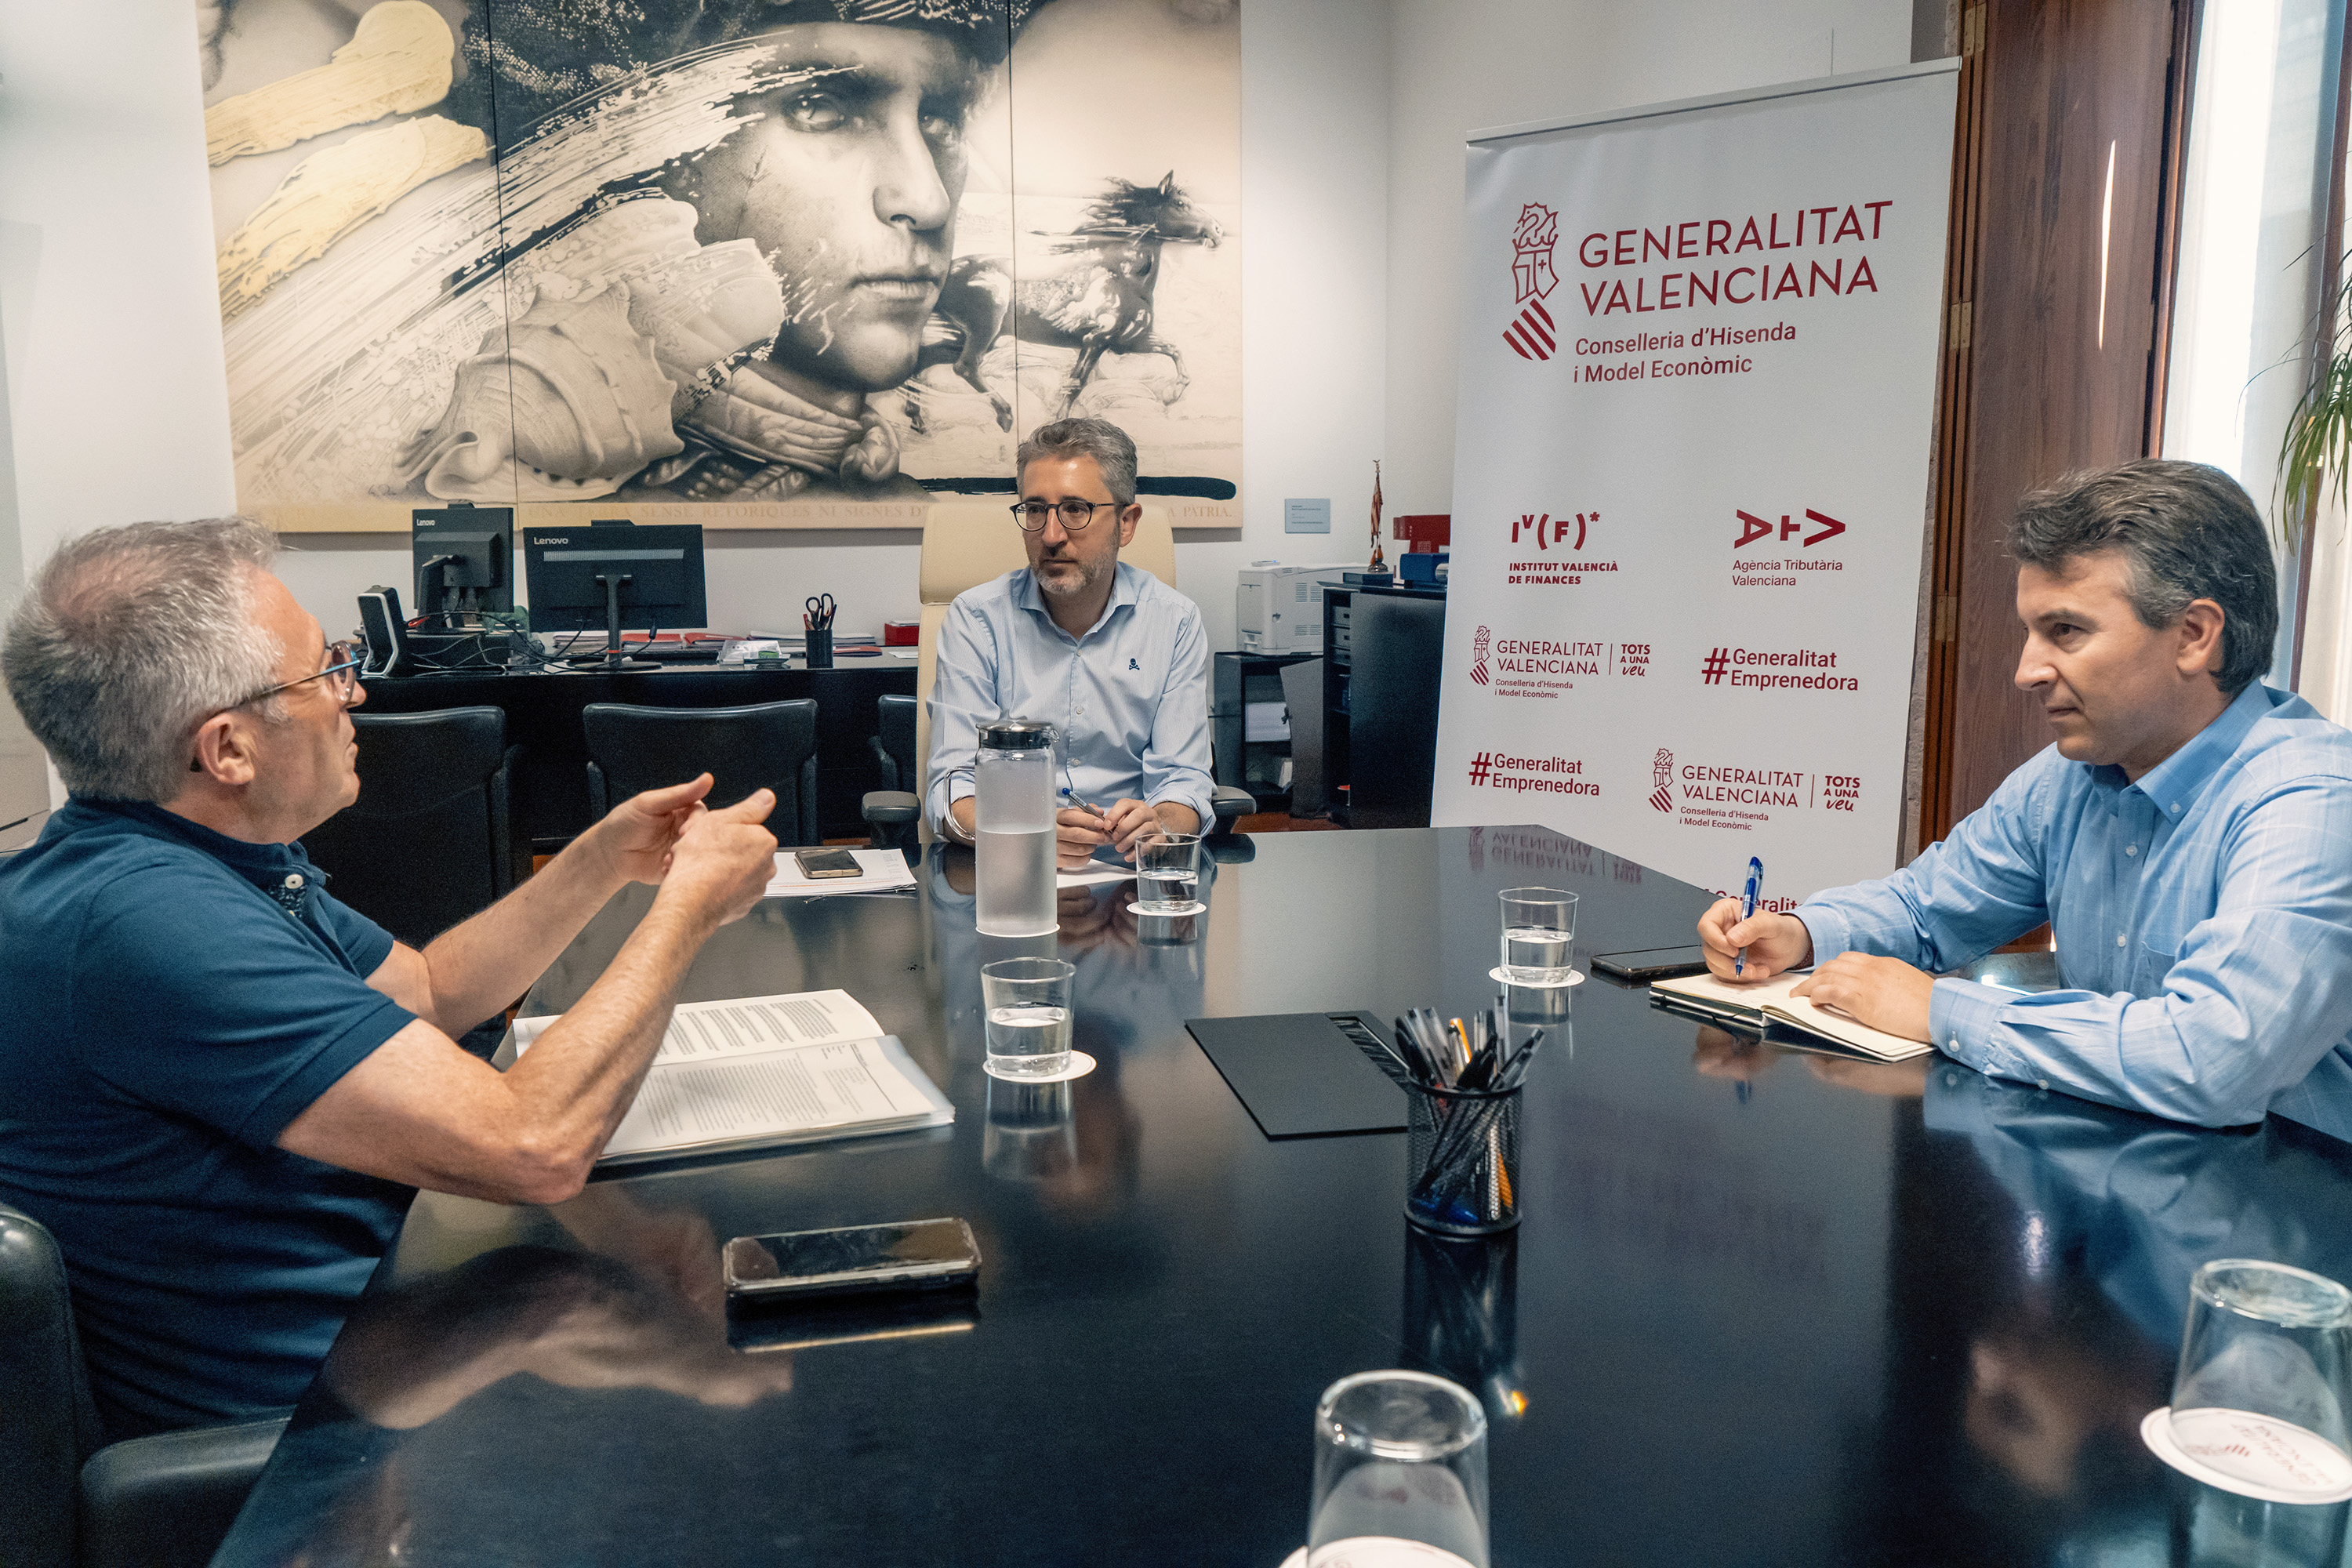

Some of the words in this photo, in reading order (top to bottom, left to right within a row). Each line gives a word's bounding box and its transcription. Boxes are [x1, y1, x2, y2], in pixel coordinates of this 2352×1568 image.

[1579, 201, 1893, 267] GENERALITAT
[1581, 256, 1878, 316] VALENCIANA
[1575, 332, 1684, 355] Conselleria
[1691, 321, 1796, 347] d'Hisenda
[1573, 366, 1578, 383] i
[1584, 360, 1645, 383] Model
[1651, 355, 1753, 378] Econòmic
[818, 506, 837, 517] NI
[844, 506, 903, 517] SIGNES
[1509, 562, 1559, 572] INSTITUT
[1561, 560, 1618, 572] VALENCIÀ
[1733, 560, 1781, 573] Agència
[1784, 559, 1843, 571] Tributària
[1508, 575, 1523, 584] DE
[1525, 575, 1581, 585] FINANCES
[1732, 575, 1797, 586] Valenciana
[1497, 639, 1604, 657] GENERALITAT
[1621, 643, 1651, 655] TOTS
[1497, 658, 1599, 675] VALENCIANA
[1620, 655, 1627, 664] A
[1629, 655, 1650, 665] UNA
[1621, 665, 1646, 677] veu
[1495, 678, 1536, 688] Conselleria
[1537, 680, 1573, 689] d'Hisenda
[1730, 670, 1859, 691] Emprenedora
[1498, 688, 1521, 697] Model
[1522, 689, 1559, 699] Econòmic
[1682, 765, 1804, 787] GENERALITAT
[1824, 775, 1860, 789] TOTS
[1493, 772, 1600, 796] Emprenedora
[1683, 785, 1798, 808] VALENCIANA
[1824, 788, 1832, 797] A
[1834, 789, 1860, 798] UNA
[1825, 798, 1854, 812] veu
[1680, 806, 1726, 818] Conselleria
[1728, 810, 1769, 821] d'Hisenda
[1684, 818, 1711, 827] Model
[1712, 820, 1752, 831] Econòmic
